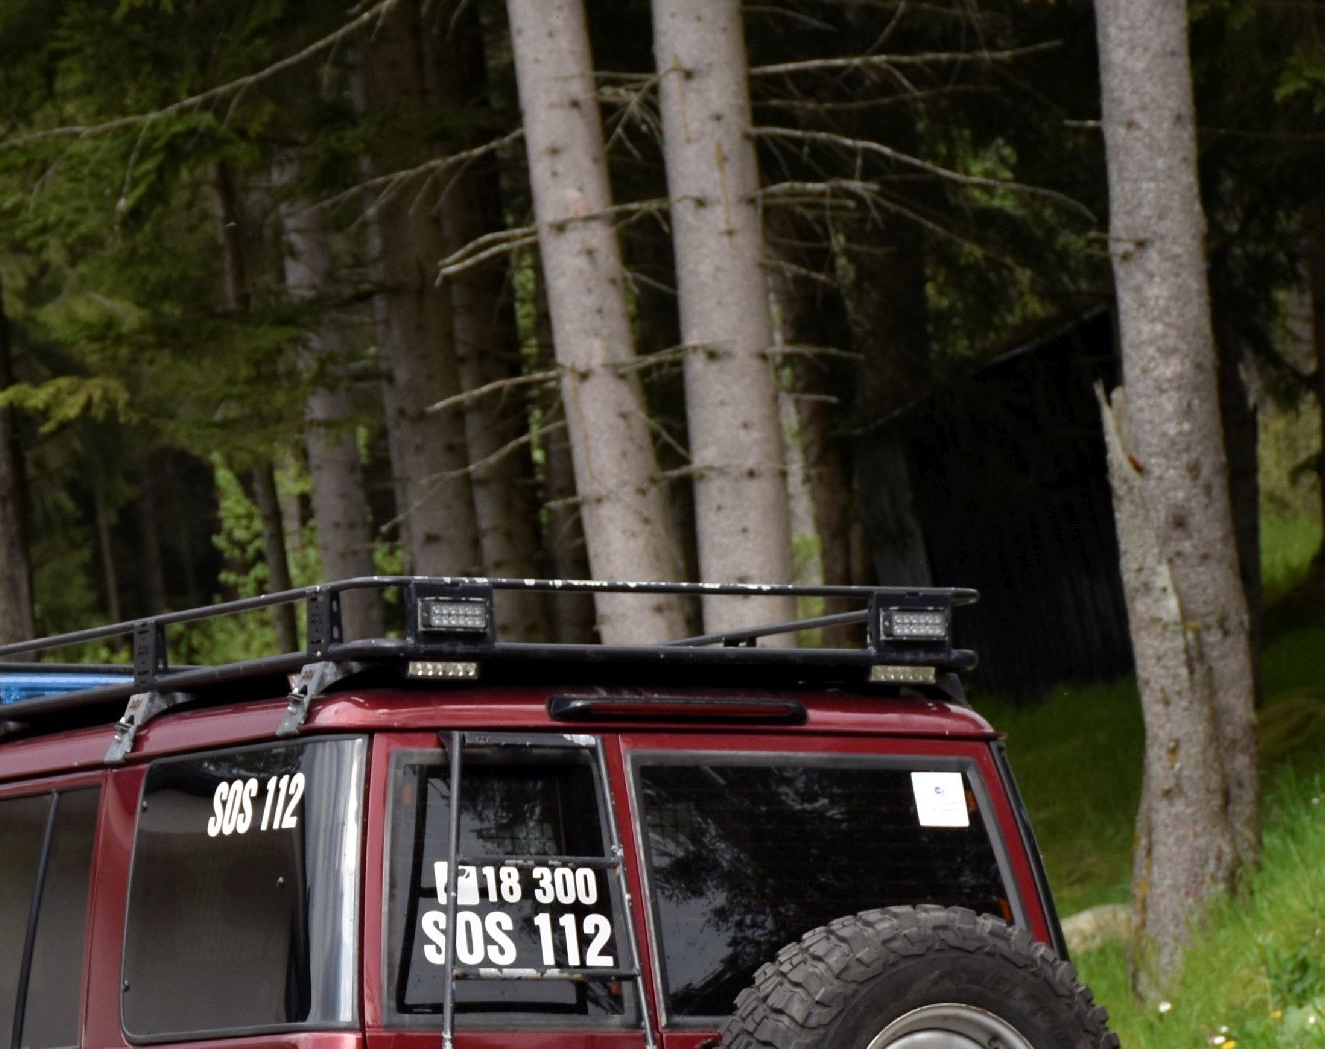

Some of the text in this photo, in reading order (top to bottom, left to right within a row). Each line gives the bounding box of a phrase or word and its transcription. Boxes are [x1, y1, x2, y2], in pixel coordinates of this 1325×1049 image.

[207, 772, 306, 837] SOS 112
[483, 866, 598, 905] 18 300
[421, 910, 615, 967] SOS 112
